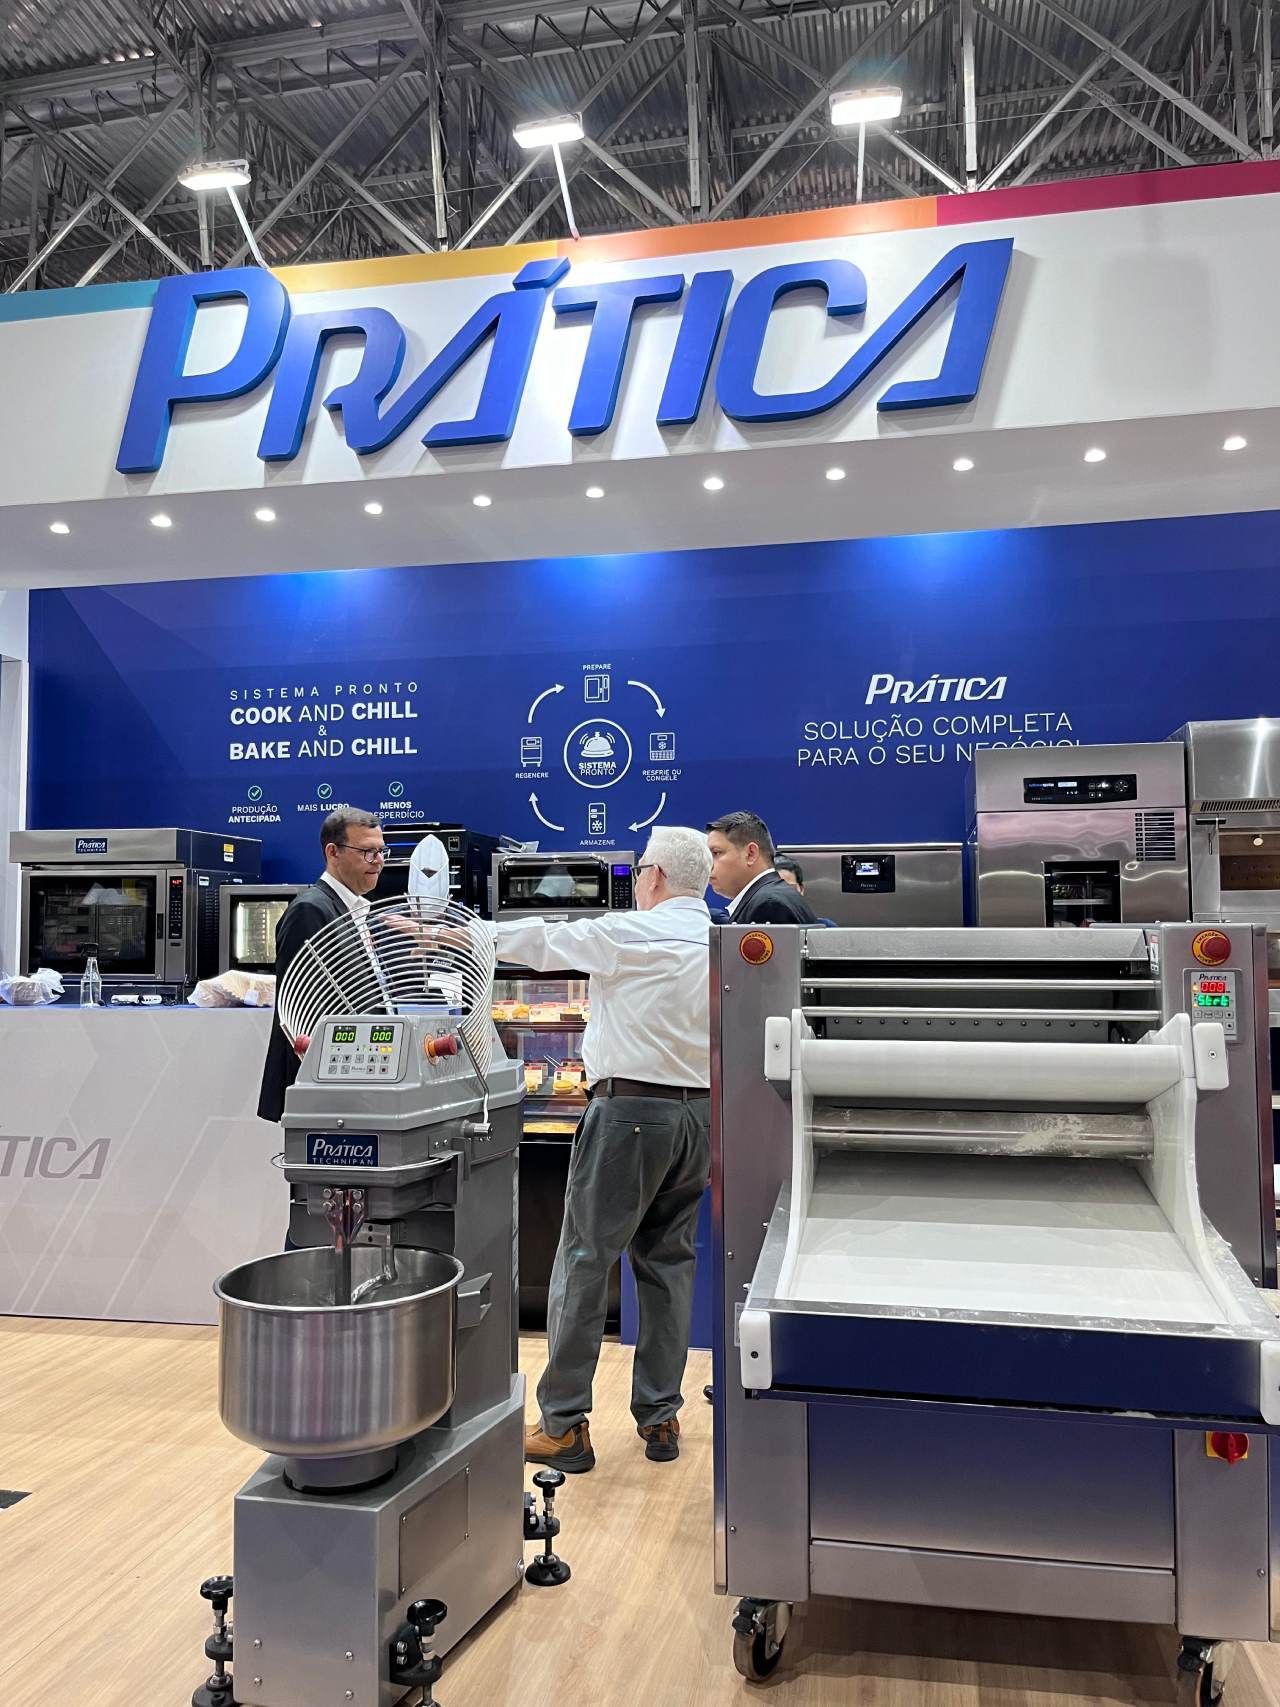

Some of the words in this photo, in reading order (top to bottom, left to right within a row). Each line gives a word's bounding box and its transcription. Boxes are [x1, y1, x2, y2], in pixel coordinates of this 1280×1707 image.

[115, 238, 1015, 474] PRÁTICA
[582, 663, 612, 671] PREPARE
[229, 686, 320, 700] SISTEMA
[335, 682, 418, 695] PRONTO
[864, 673, 1008, 705] PRÁTICA
[230, 706, 292, 725] COOK
[298, 704, 345, 722] AND
[351, 701, 418, 720] CHILL
[318, 724, 328, 736] &
[804, 714, 923, 743] SOLUÇÃO
[933, 712, 1073, 737] COMPLETA
[229, 741, 291, 760] BAKE
[297, 740, 344, 757] AND
[351, 737, 418, 755] CHILL
[798, 747, 860, 767] PARA
[868, 746, 886, 765] O
[895, 744, 945, 764] SEU
[578, 762, 617, 770] SISTEMA
[515, 771, 549, 779] REGENERE
[580, 768, 615, 776] PRONTO
[231, 804, 278, 815] PRODUÇÃO
[297, 804, 318, 812] MAIS
[380, 801, 412, 810] MENOS
[228, 814, 281, 823] ANTECIPADA
[370, 809, 425, 819] ESPERDÍCIO
[335, 1031, 355, 1041] 000
[372, 1031, 392, 1041] 000
[312, 1138, 373, 1157] PRÁTICA
[0, 1136, 111, 1179] TICA
[312, 1157, 374, 1165] TECHNIPAN
